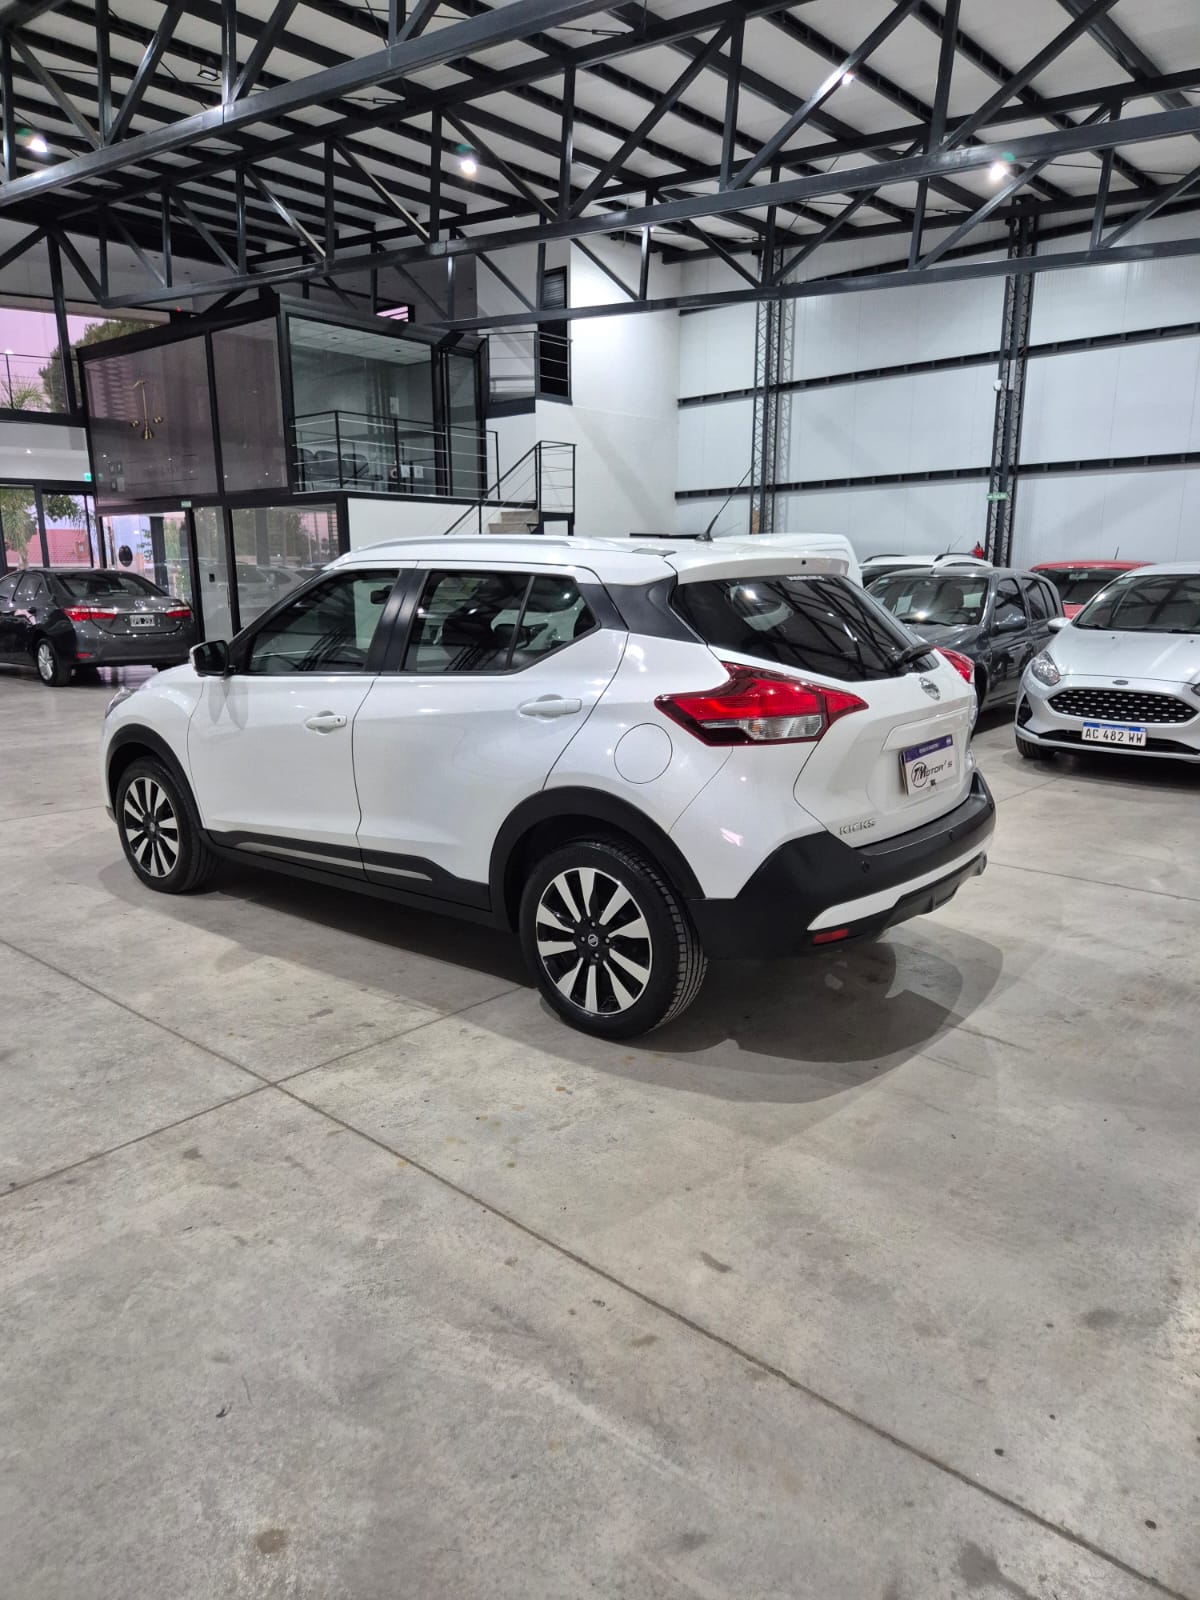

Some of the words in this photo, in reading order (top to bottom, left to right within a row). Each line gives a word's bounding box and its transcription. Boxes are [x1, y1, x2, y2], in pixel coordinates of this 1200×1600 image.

[1085, 728, 1099, 739] AC
[1103, 730, 1124, 742] 482
[839, 818, 875, 836] KICKS
